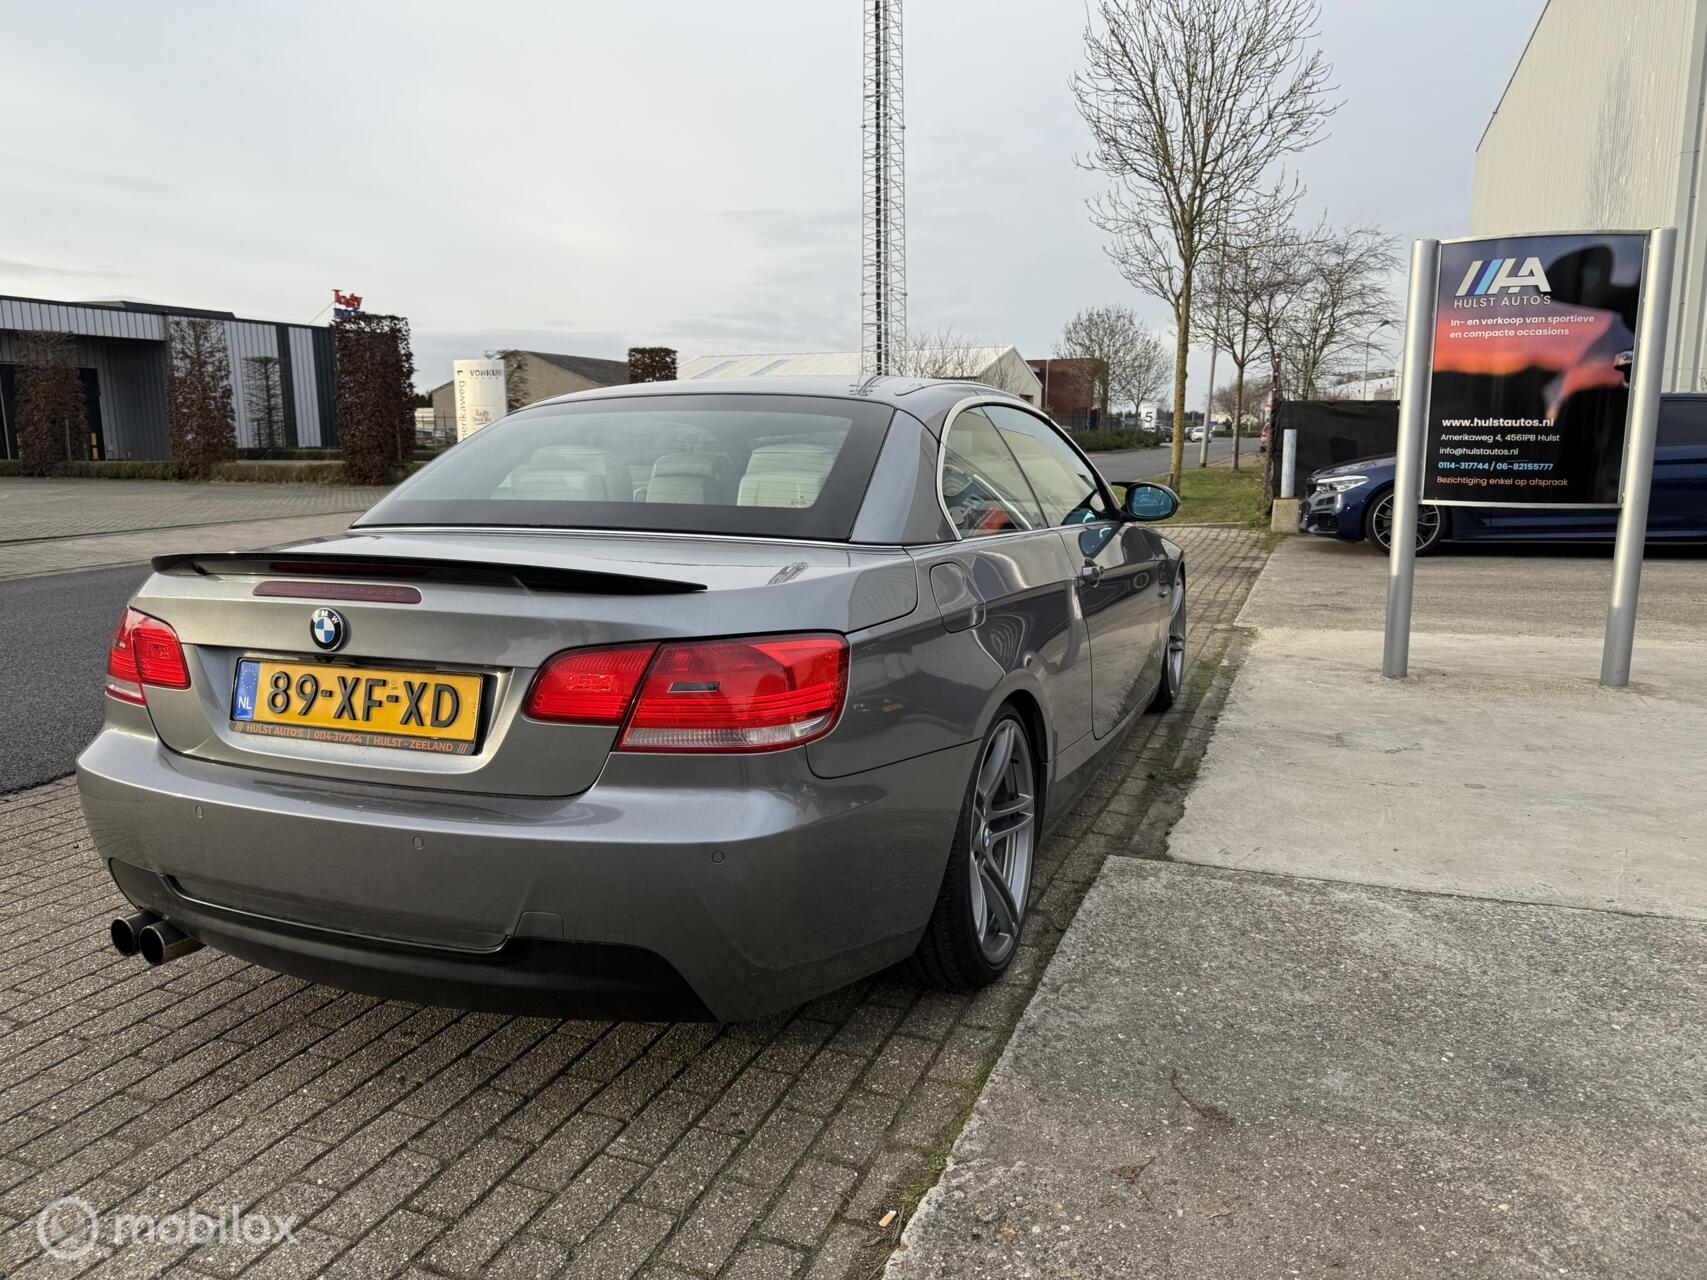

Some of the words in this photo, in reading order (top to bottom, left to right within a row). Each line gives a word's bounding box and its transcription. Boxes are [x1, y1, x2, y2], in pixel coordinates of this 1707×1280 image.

[1454, 297, 1496, 309] HULST
[1501, 294, 1552, 306] AUTO'S
[1450, 319, 1465, 327] In-
[1481, 316, 1523, 327] verkoop
[1525, 316, 1546, 324] van
[1547, 314, 1595, 326] sportieve
[1463, 328, 1514, 340] compacte
[1517, 327, 1570, 337] occasions
[458, 380, 468, 440] erikaweg
[1144, 411, 1153, 423] 5
[1442, 417, 1554, 427] www.hulstautos.nl
[1440, 433, 1494, 443] Amerikaweg
[1495, 434, 1503, 442] 4,
[1538, 433, 1560, 442] Hulst
[1439, 446, 1519, 456] info@hulstautos.nl
[1438, 461, 1489, 470] 0114-317744
[1496, 462, 1554, 471] 06-82155777
[1436, 475, 1487, 486] Bezichtiging
[1489, 477, 1513, 485] enkel
[1515, 479, 1527, 487] op
[1528, 477, 1568, 487] afspraak
[312, 609, 340, 625] MW
[238, 695, 252, 710] NL
[267, 671, 460, 728] 89-XF-XD
[246, 723, 273, 735] HULST
[273, 727, 304, 738] AUTO'S
[374, 736, 401, 747] HULST
[409, 740, 453, 752] ZEELAND
